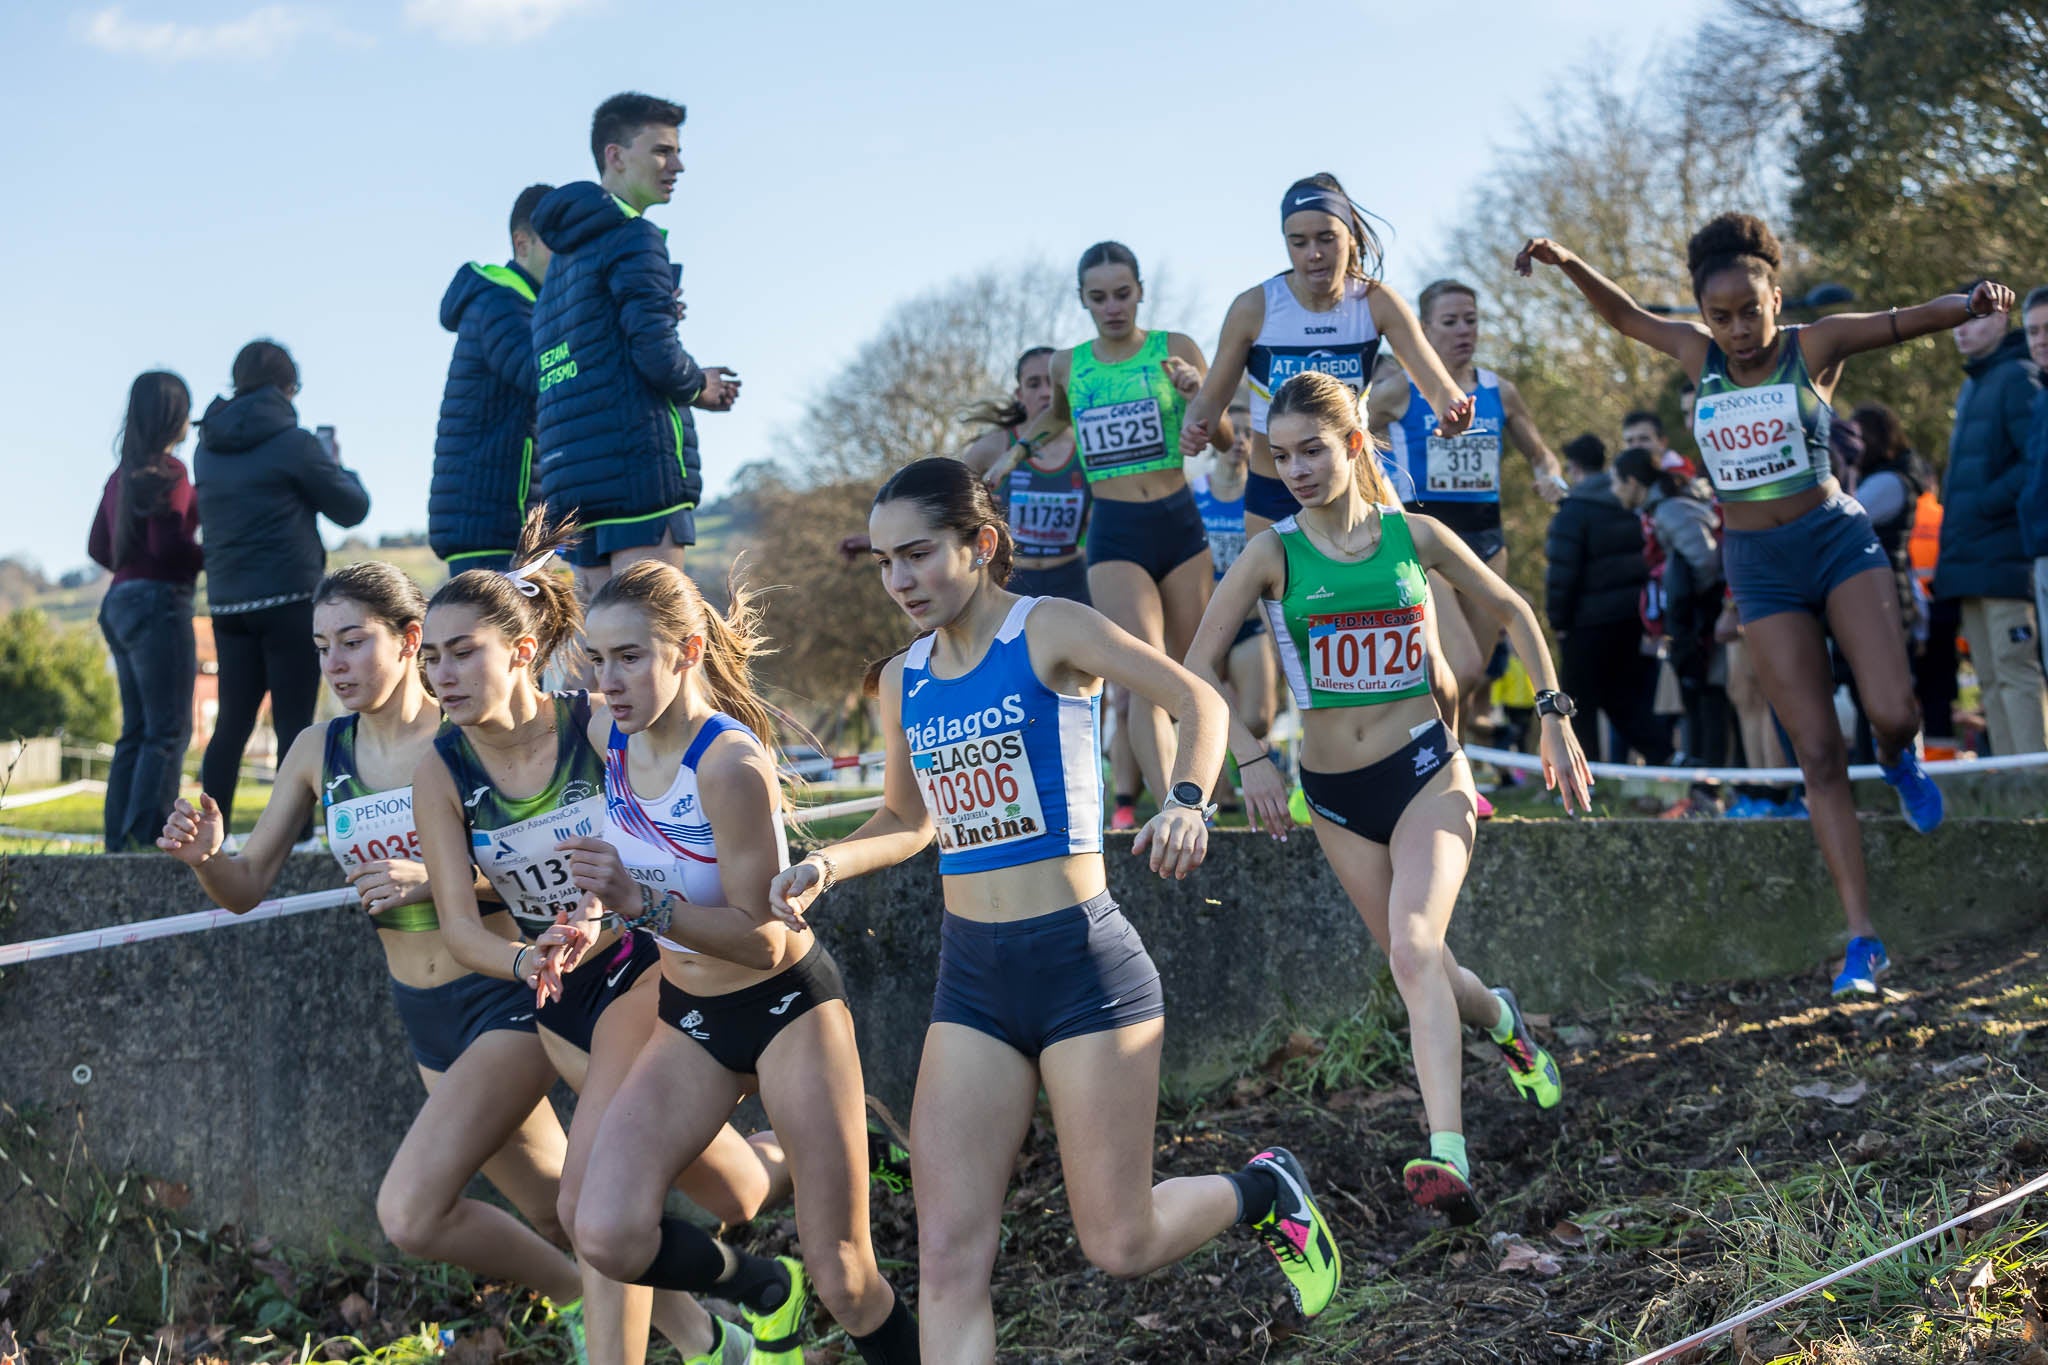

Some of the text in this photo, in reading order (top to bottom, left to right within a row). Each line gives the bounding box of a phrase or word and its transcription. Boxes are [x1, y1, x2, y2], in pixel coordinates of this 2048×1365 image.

[1081, 416, 1159, 453] 11525
[1707, 418, 1787, 452] 10362
[1447, 451, 1482, 472] 313
[1019, 506, 1077, 529] 11733
[1315, 626, 1422, 678] 10126
[1314, 677, 1387, 690] Talleres Curta
[928, 763, 1019, 816] 10306
[349, 830, 424, 865] 1035
[952, 816, 1039, 849] Encina
